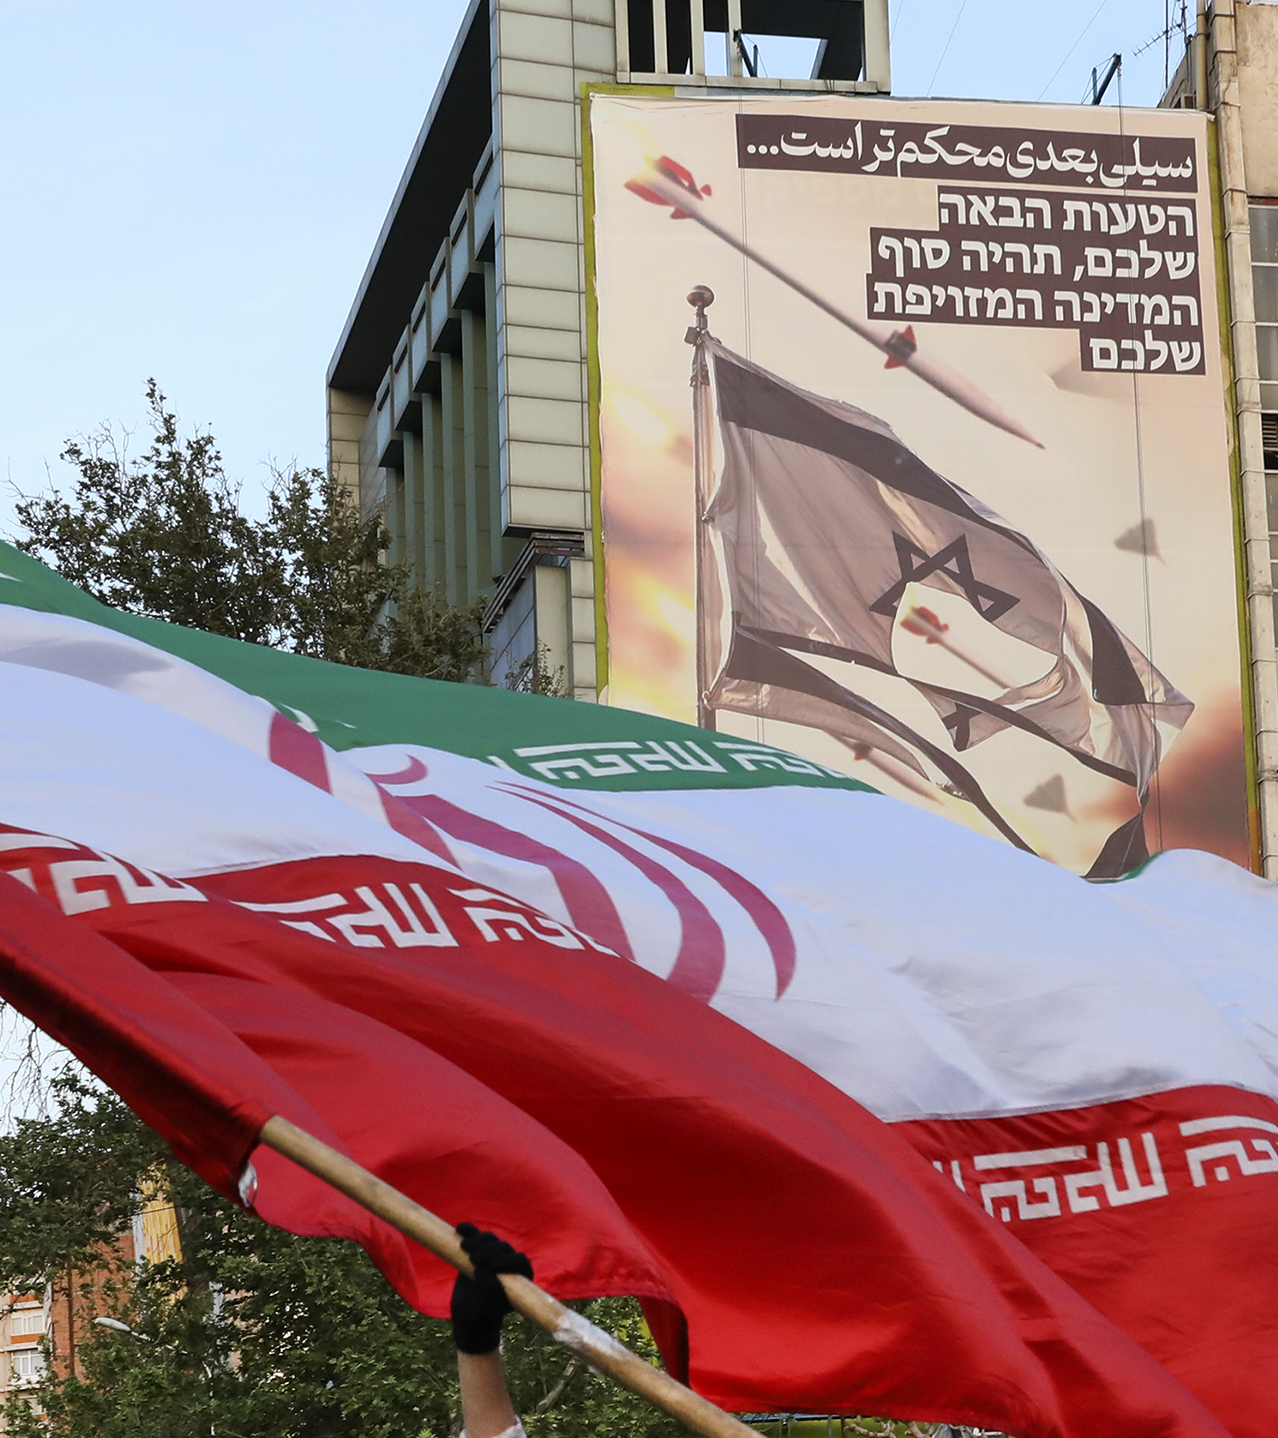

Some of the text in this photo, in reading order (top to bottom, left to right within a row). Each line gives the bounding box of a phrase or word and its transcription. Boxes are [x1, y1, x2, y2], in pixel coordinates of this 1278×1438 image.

[1006, 141, 1100, 185] بعدی
[1098, 138, 1193, 188] سیلی
[938, 193, 1195, 237] הטעות הבאה
[877, 235, 1196, 282] שלכם, תהיה סוף
[873, 281, 1199, 326] המדינה המזויפת
[1089, 329, 1202, 372] שלכם
